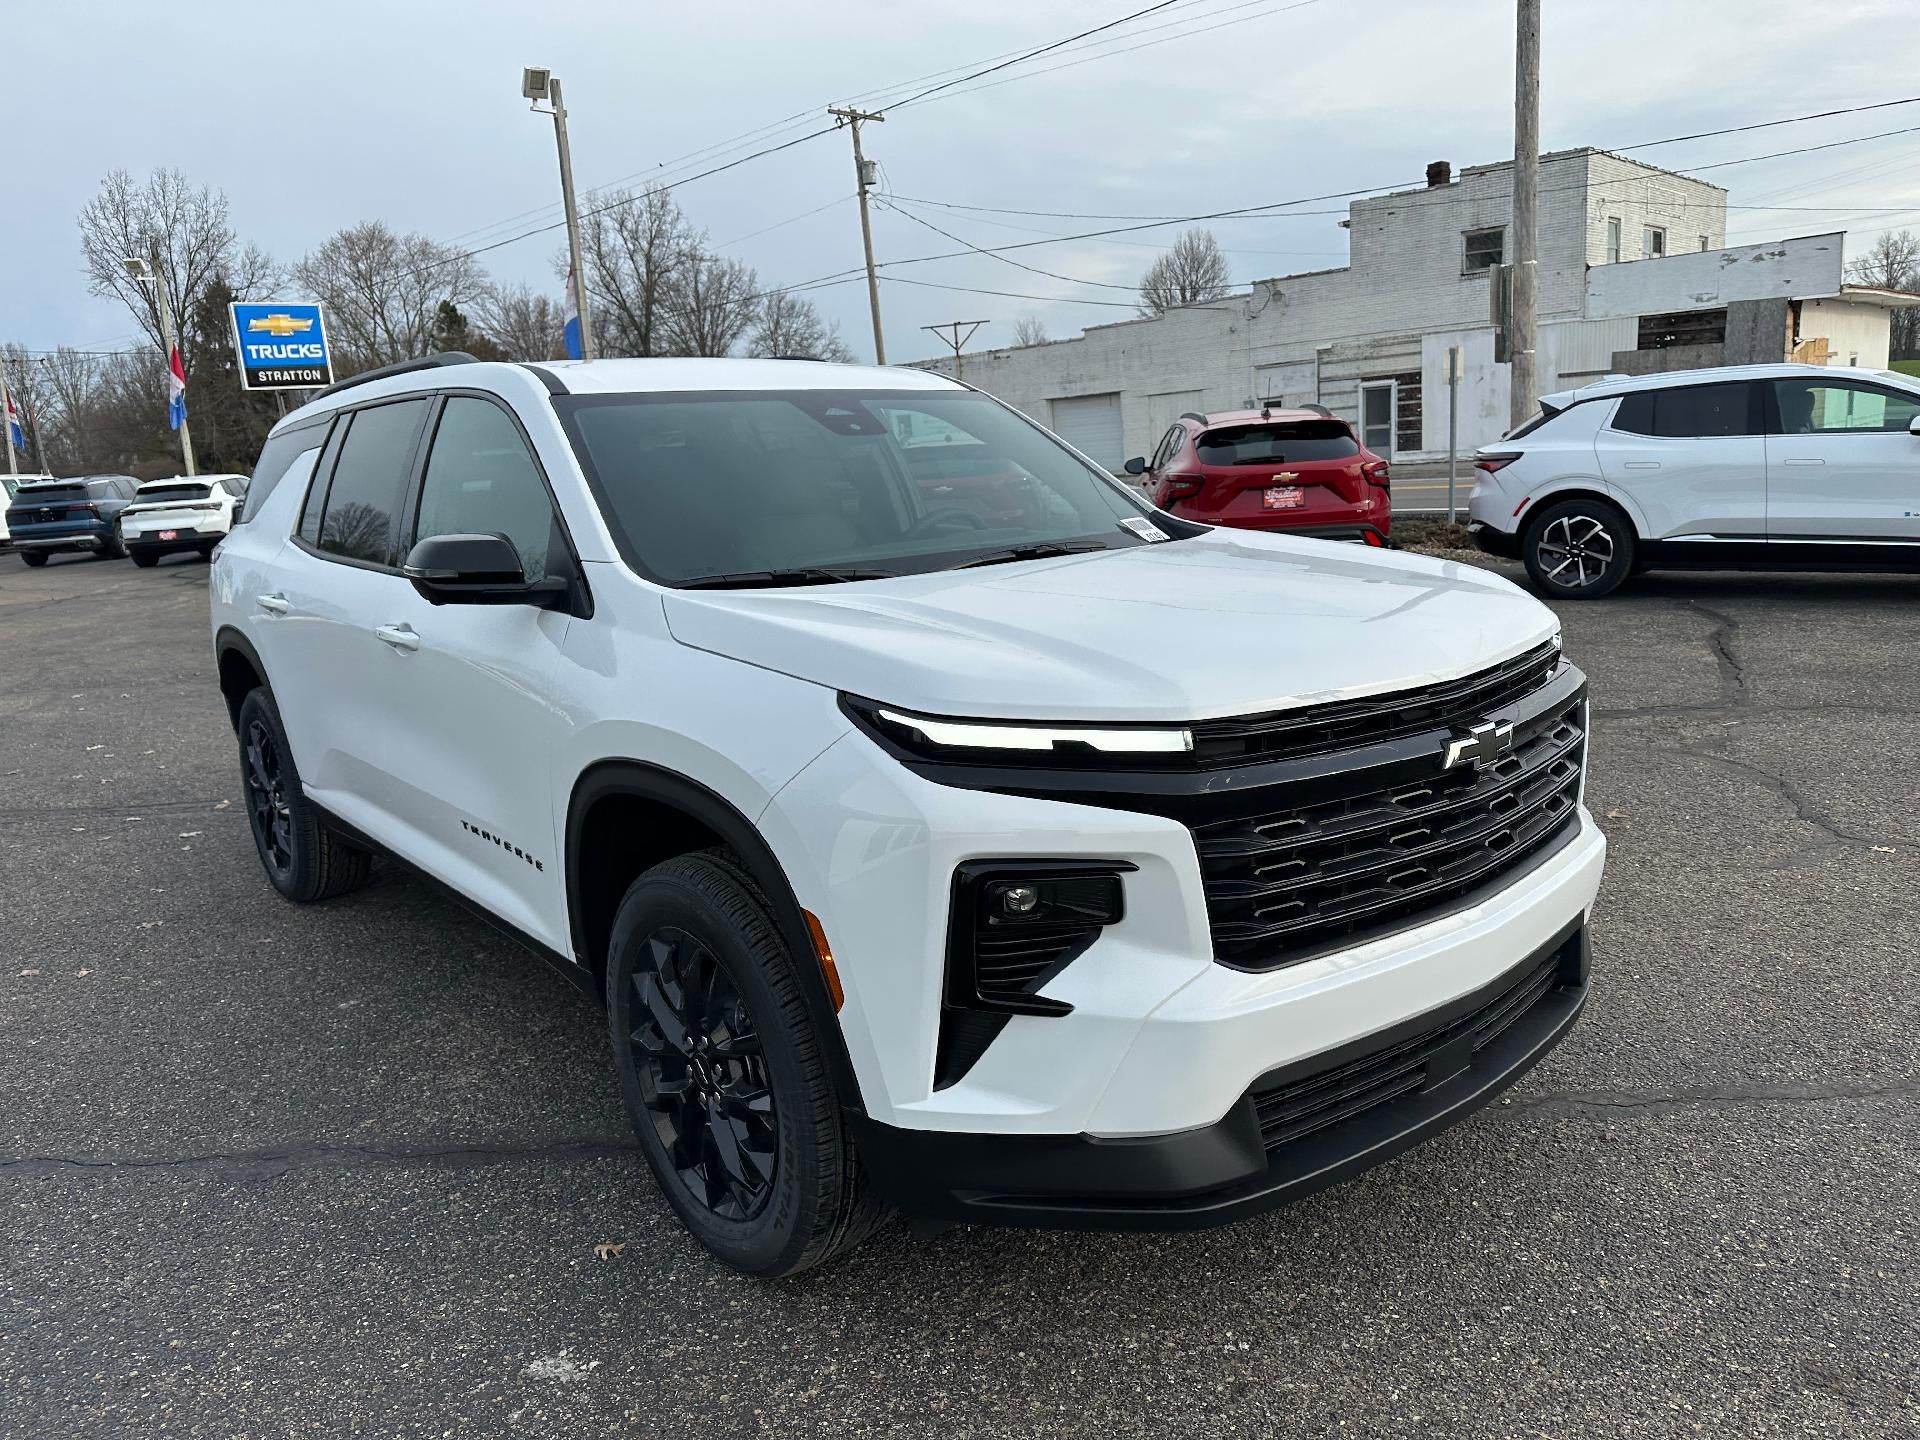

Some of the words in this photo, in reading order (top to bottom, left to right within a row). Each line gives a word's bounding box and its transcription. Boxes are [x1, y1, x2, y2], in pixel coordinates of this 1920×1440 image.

[247, 344, 323, 359] TRUCKS
[258, 369, 321, 381] STRATTON
[460, 820, 544, 872] TRAVERSE
